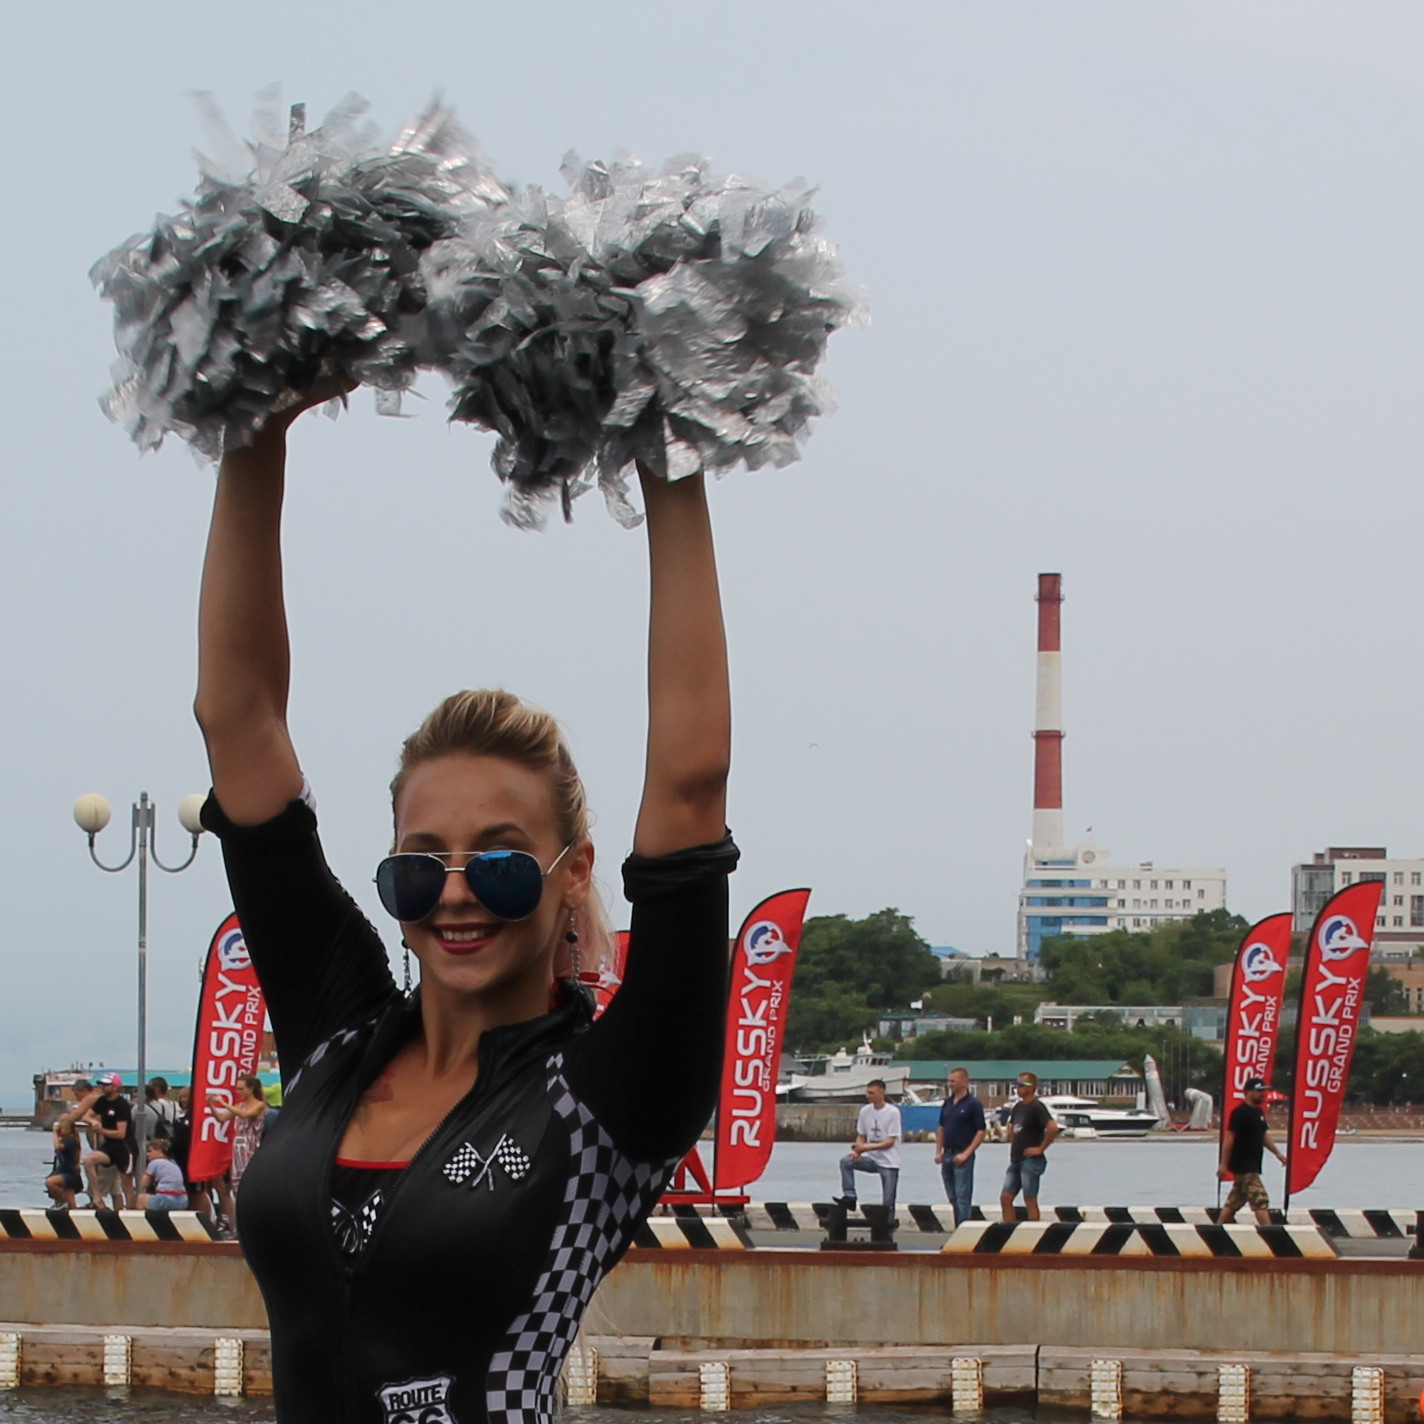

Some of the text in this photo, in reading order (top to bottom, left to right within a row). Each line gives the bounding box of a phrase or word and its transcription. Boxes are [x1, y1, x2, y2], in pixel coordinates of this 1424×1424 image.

[238, 985, 261, 1077] RAND PRIX
[730, 968, 771, 1147] RUSSKY
[763, 980, 784, 1092] GRAND PRIX
[1263, 996, 1277, 1031] PRIX
[1300, 964, 1347, 1149] RUSSKY
[1328, 977, 1361, 1093] GRAND PRIX
[389, 1382, 443, 1411] ROUTE
